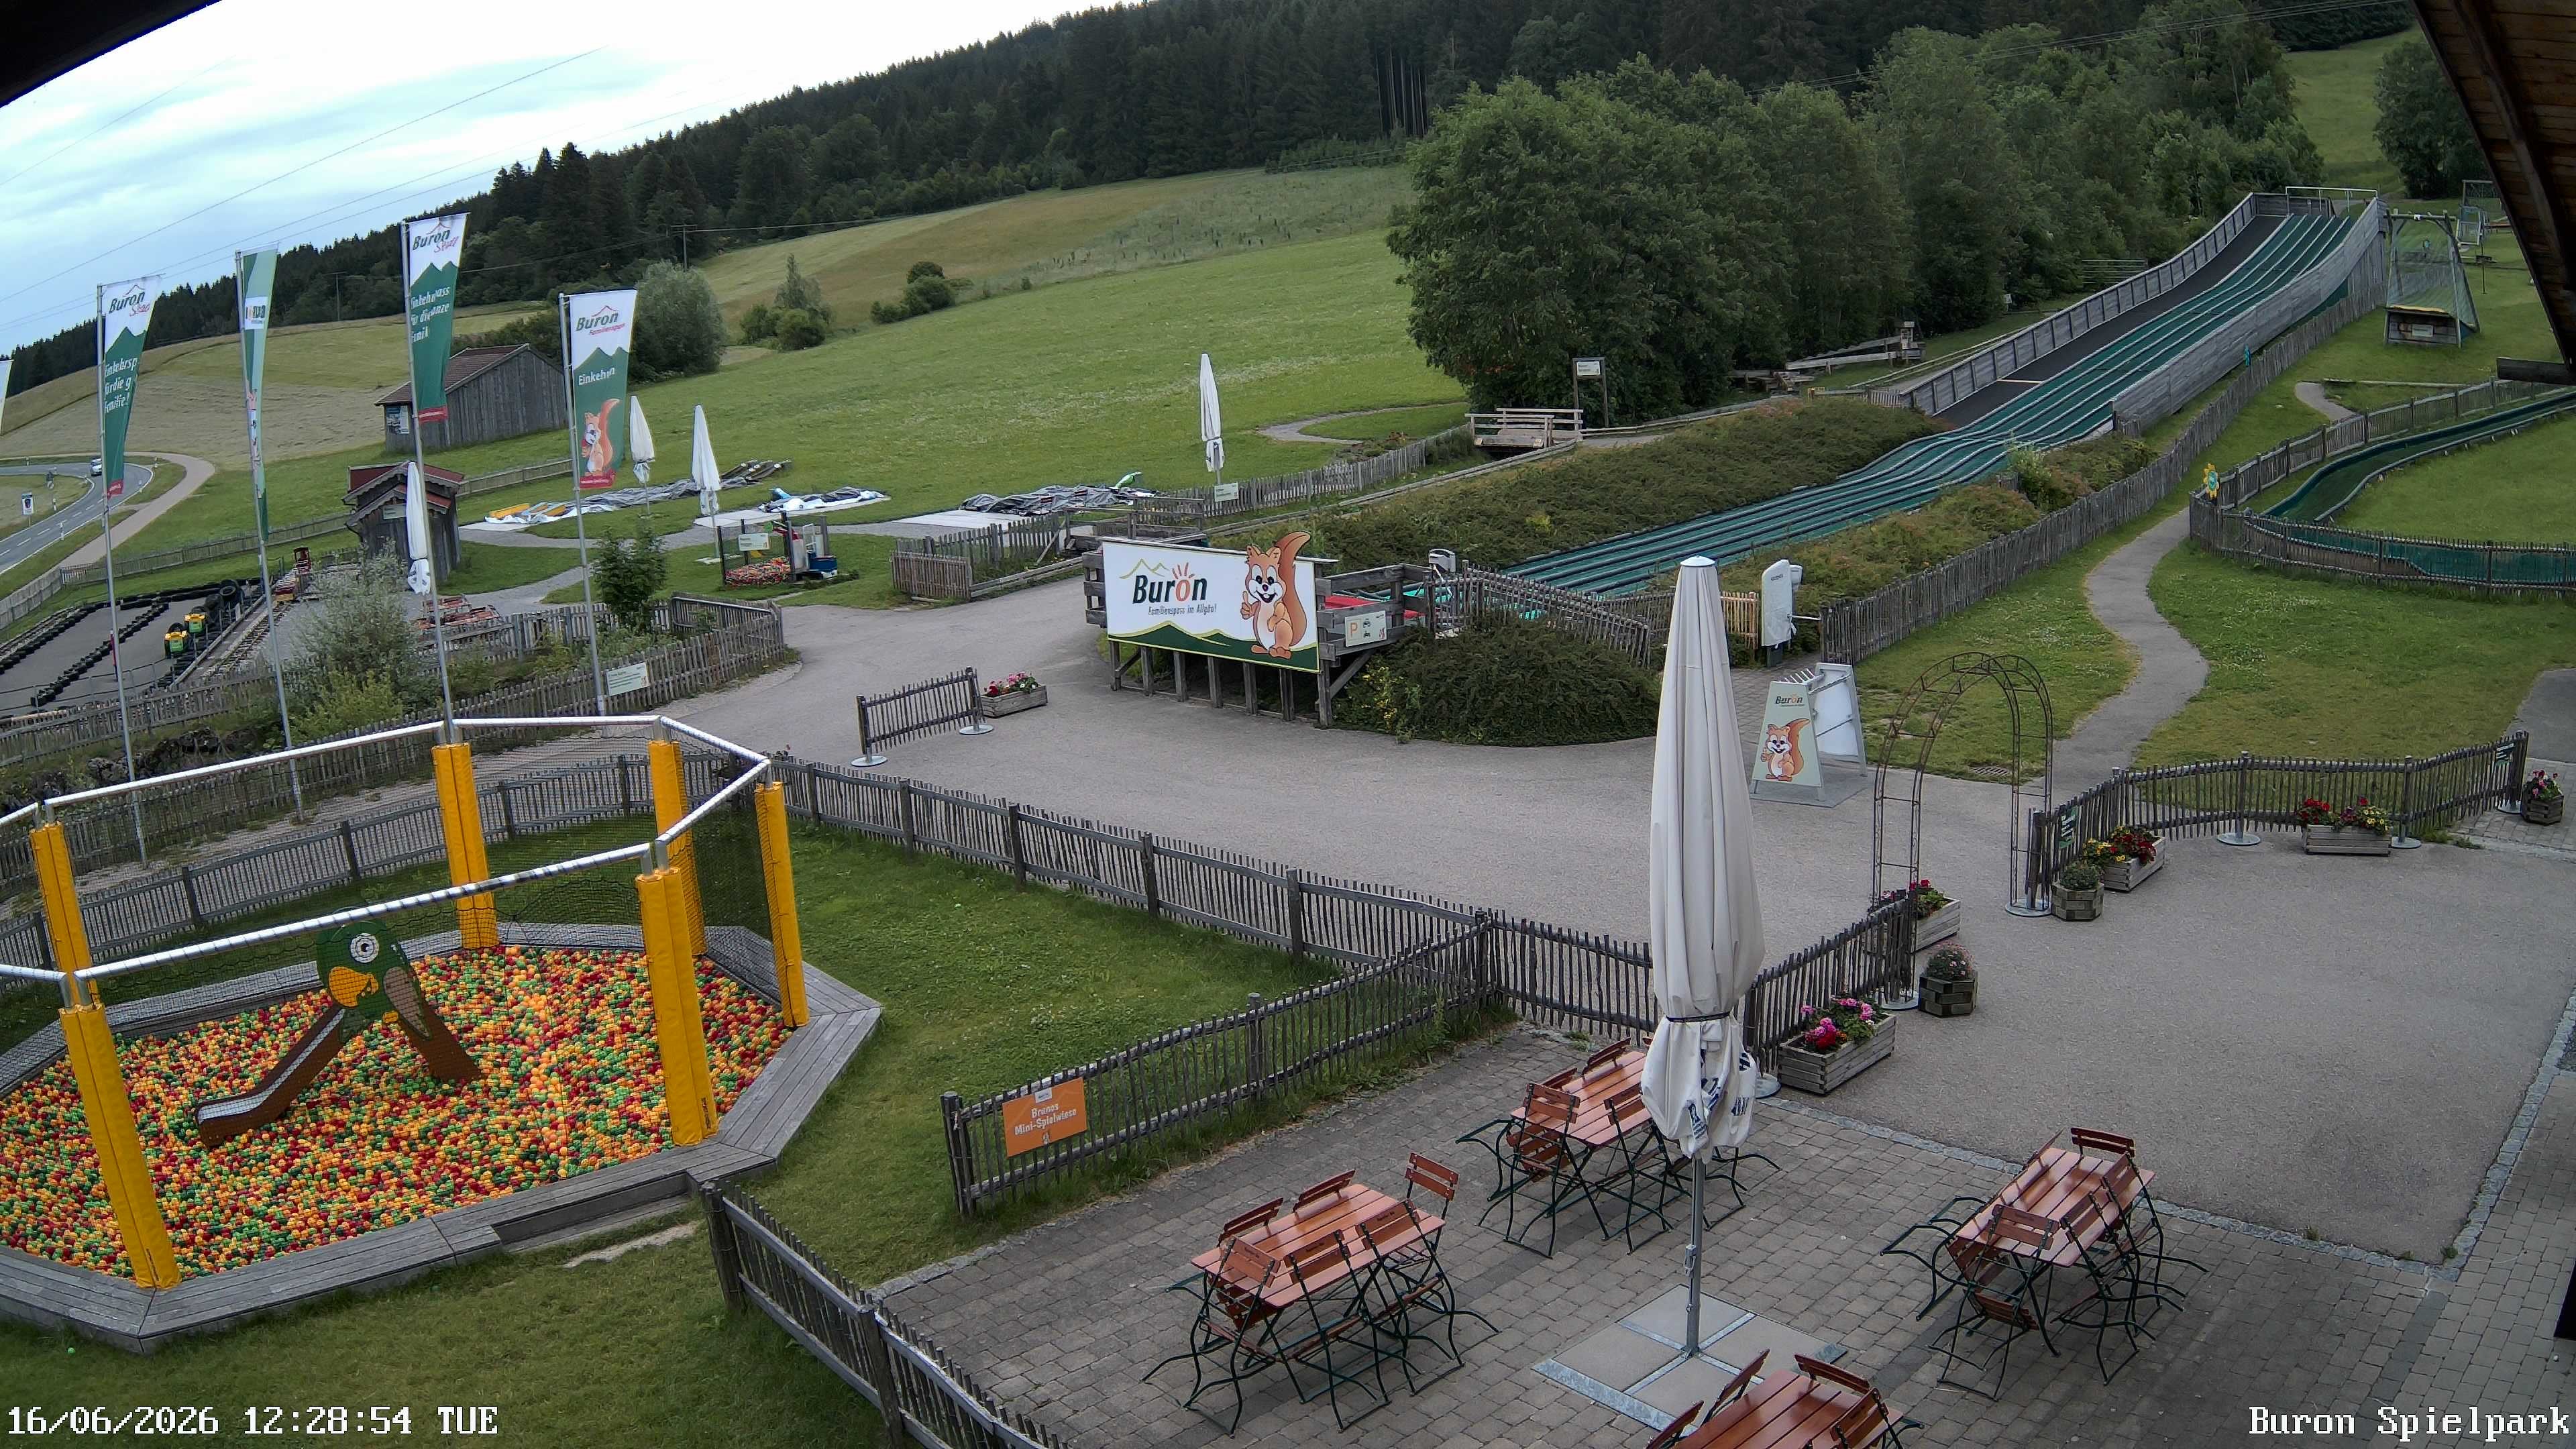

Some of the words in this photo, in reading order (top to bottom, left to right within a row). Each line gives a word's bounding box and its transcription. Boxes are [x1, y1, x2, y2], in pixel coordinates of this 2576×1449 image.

[412, 230, 451, 251] Buron
[109, 292, 146, 314] Buron
[576, 312, 619, 331] Buron
[1132, 575, 1208, 604] Buron
[1350, 622, 1358, 638] P
[1014, 1109, 1077, 1136] Mini-Spielwiese
